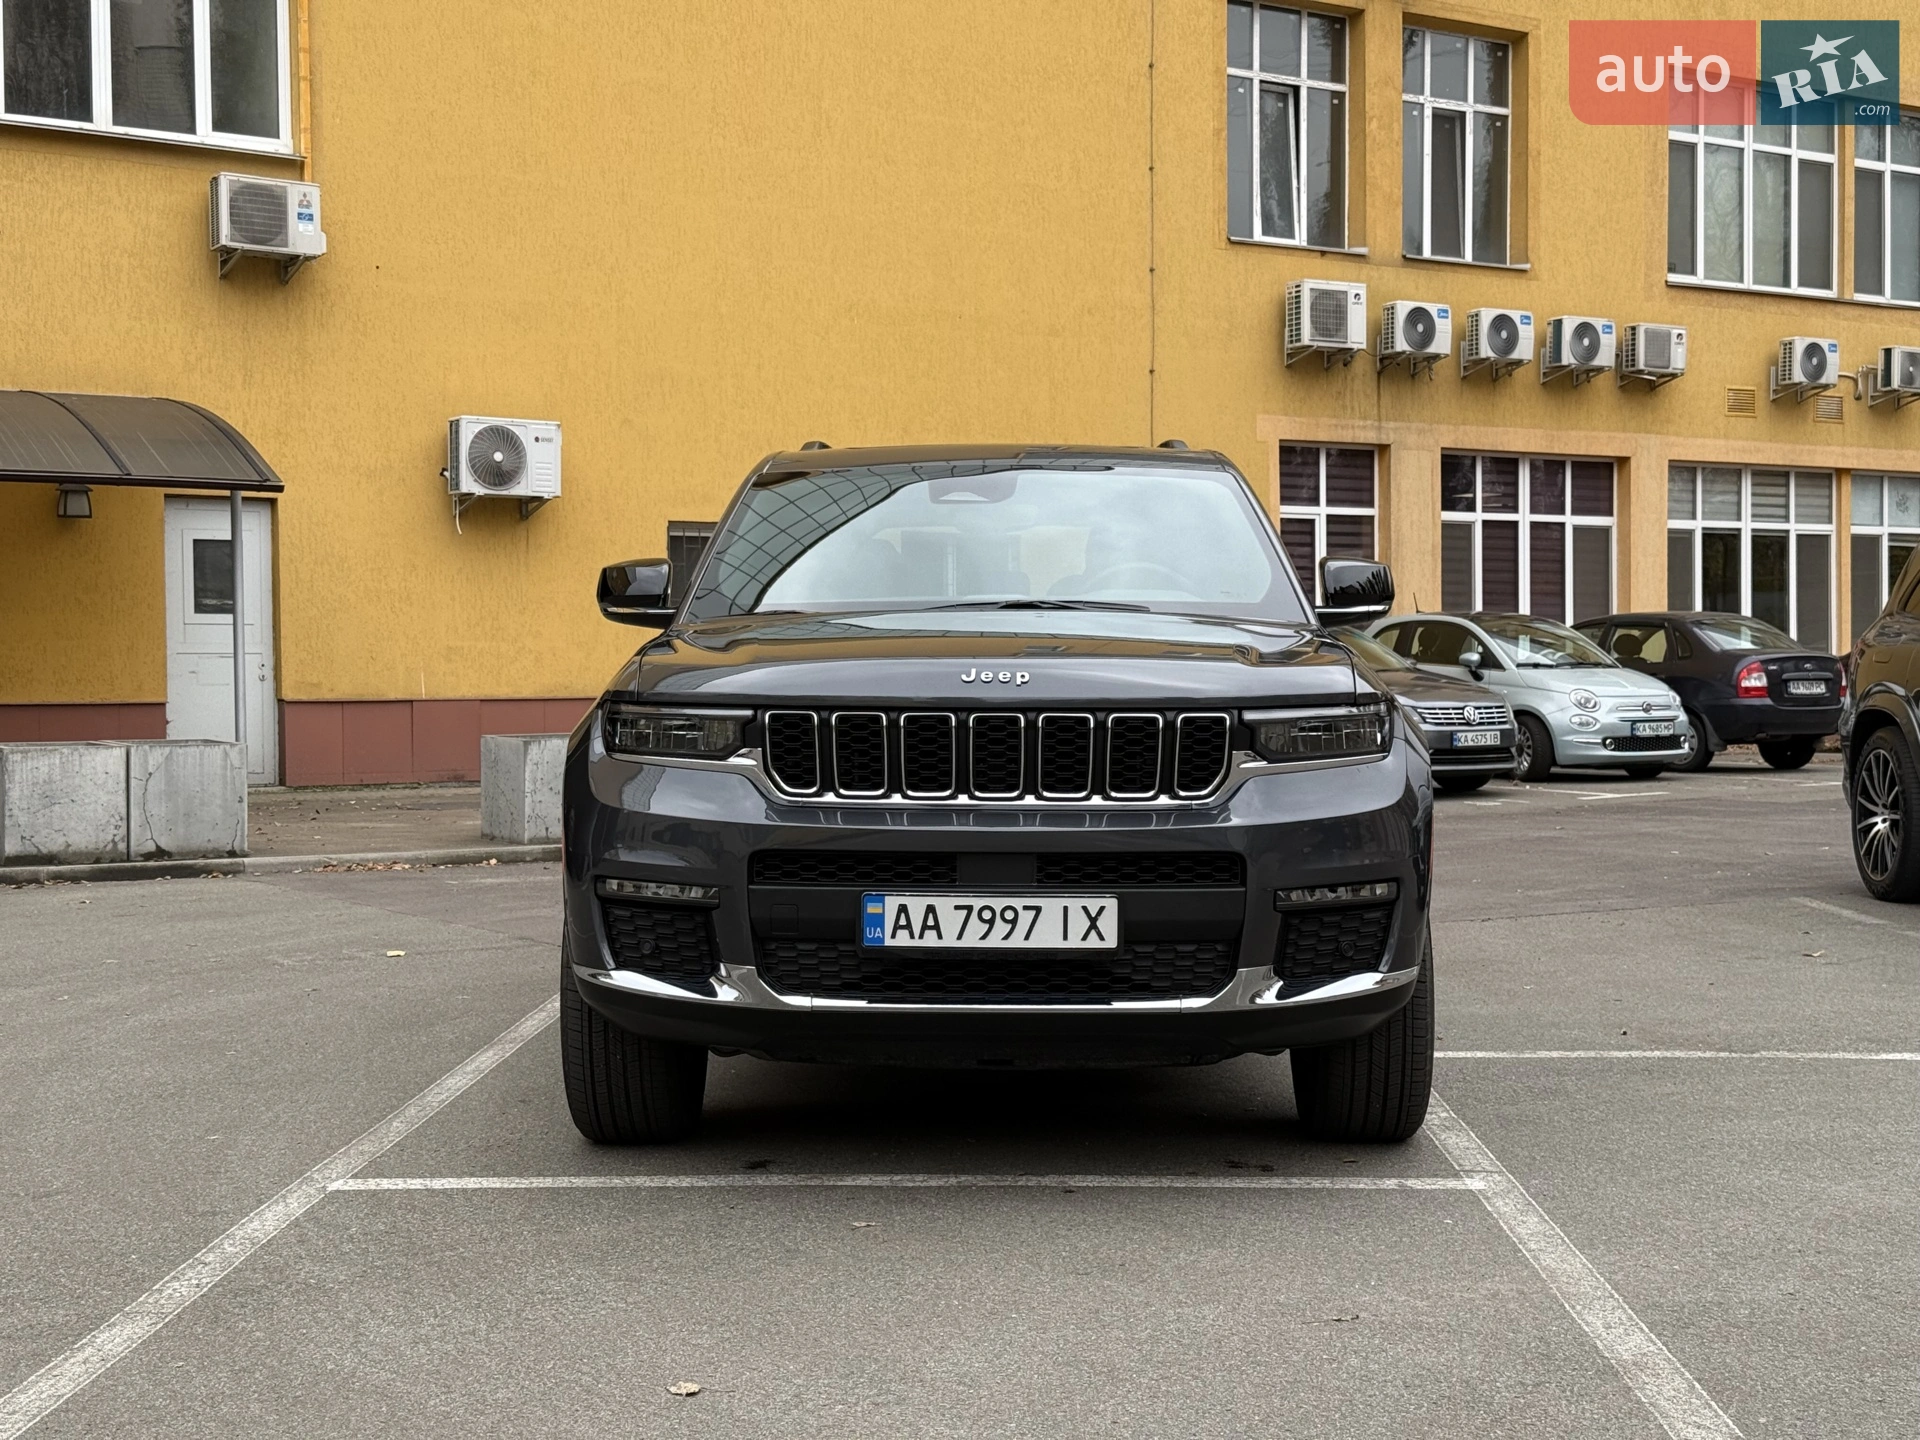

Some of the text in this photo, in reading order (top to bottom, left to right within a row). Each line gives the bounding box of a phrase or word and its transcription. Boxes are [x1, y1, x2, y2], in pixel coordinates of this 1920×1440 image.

[960, 667, 1030, 686] Jeep
[1636, 723, 1647, 734] KA
[1457, 733, 1499, 745] KA 4575 IB
[890, 903, 1107, 941] AA 7997 IX
[866, 927, 883, 938] UA
